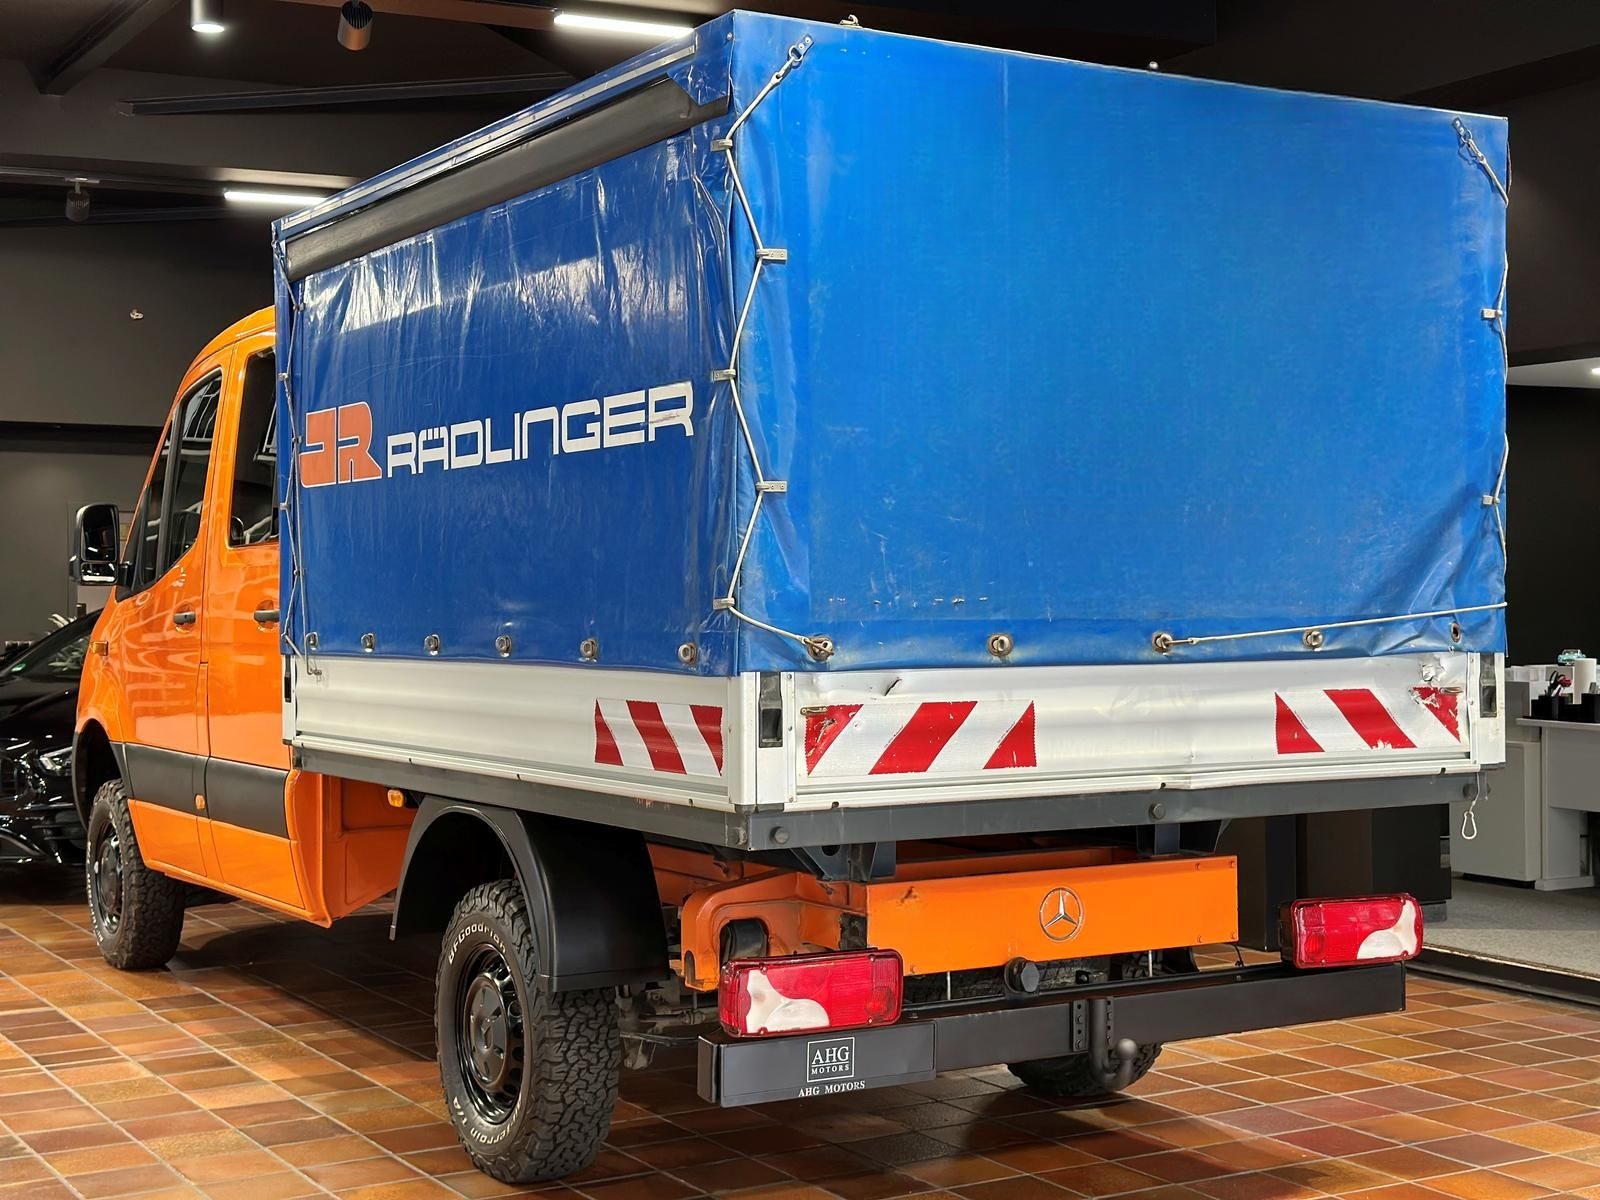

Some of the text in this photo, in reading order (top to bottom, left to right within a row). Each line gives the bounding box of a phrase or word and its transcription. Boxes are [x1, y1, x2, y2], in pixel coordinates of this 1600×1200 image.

[387, 380, 694, 478] RÄDLINGER
[811, 1046, 850, 1065] AHG
[811, 1064, 850, 1075] MOTORS
[798, 1080, 866, 1097] AHG MOTORS
